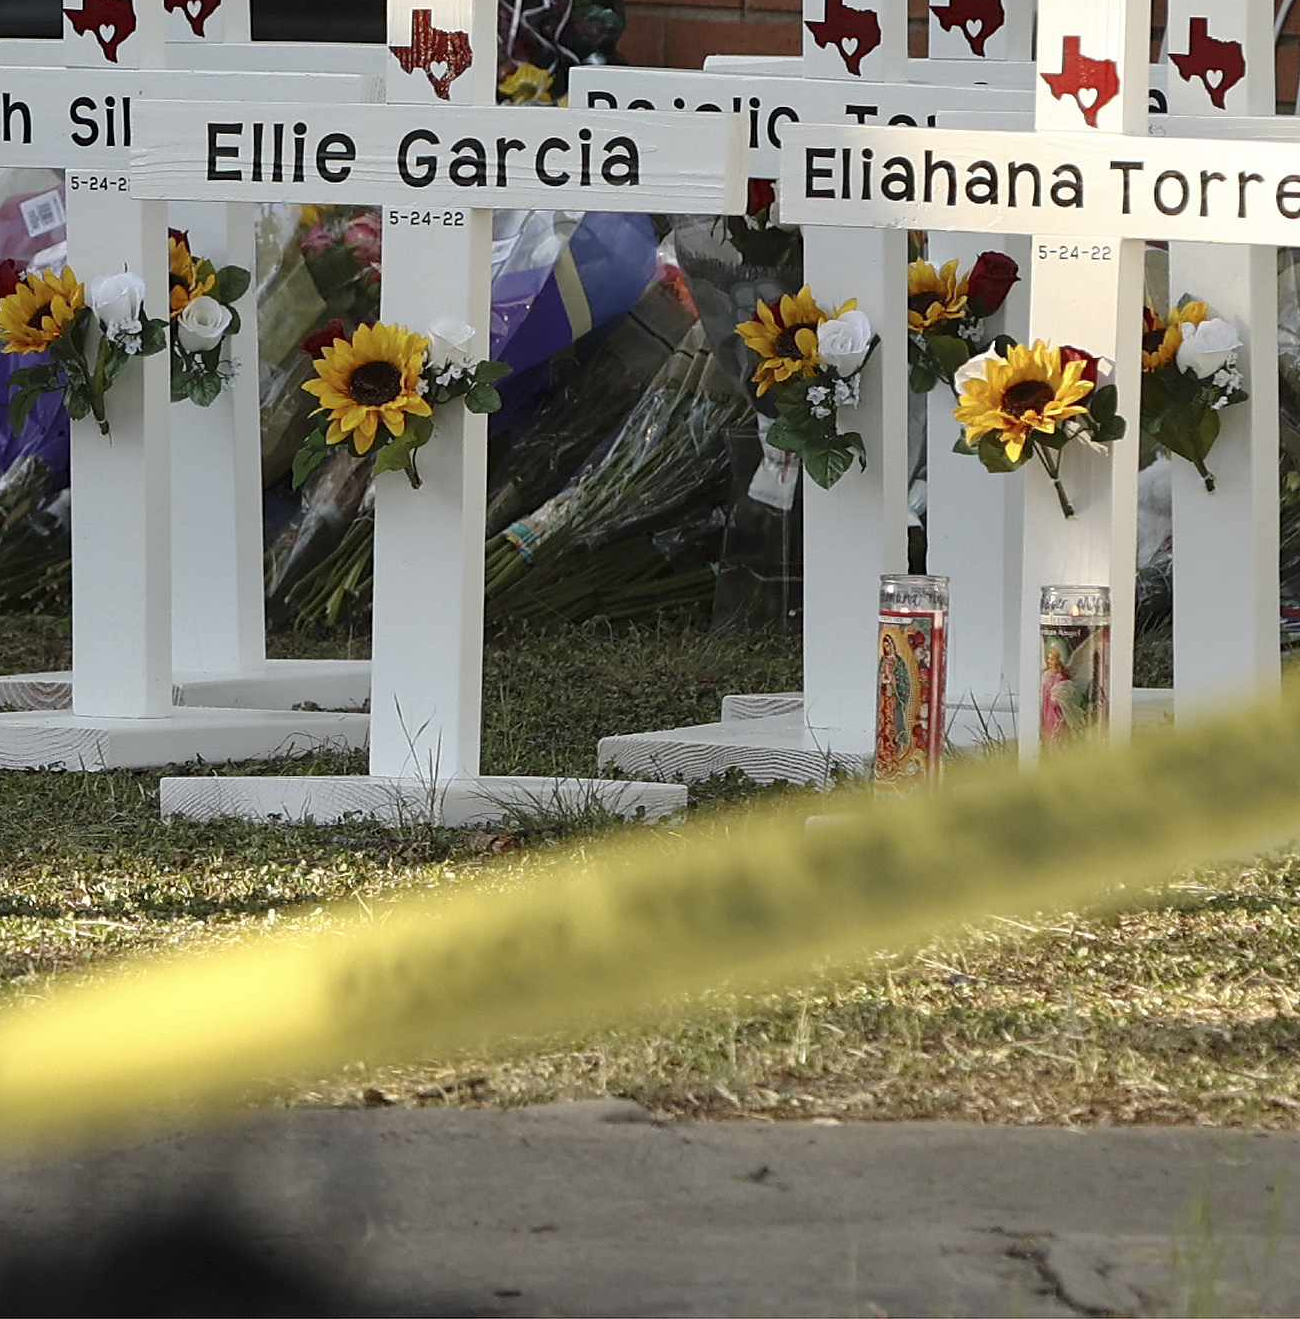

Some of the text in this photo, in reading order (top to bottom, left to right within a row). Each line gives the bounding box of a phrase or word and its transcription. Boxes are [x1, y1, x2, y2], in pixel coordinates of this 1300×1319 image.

[207, 122, 639, 188] Ellie Garcia
[70, 176, 129, 192] 5-24-2
[805, 147, 1084, 209] Eliahana
[389, 210, 465, 227] 5-24-22
[1038, 245, 1113, 261] 5-24-22
